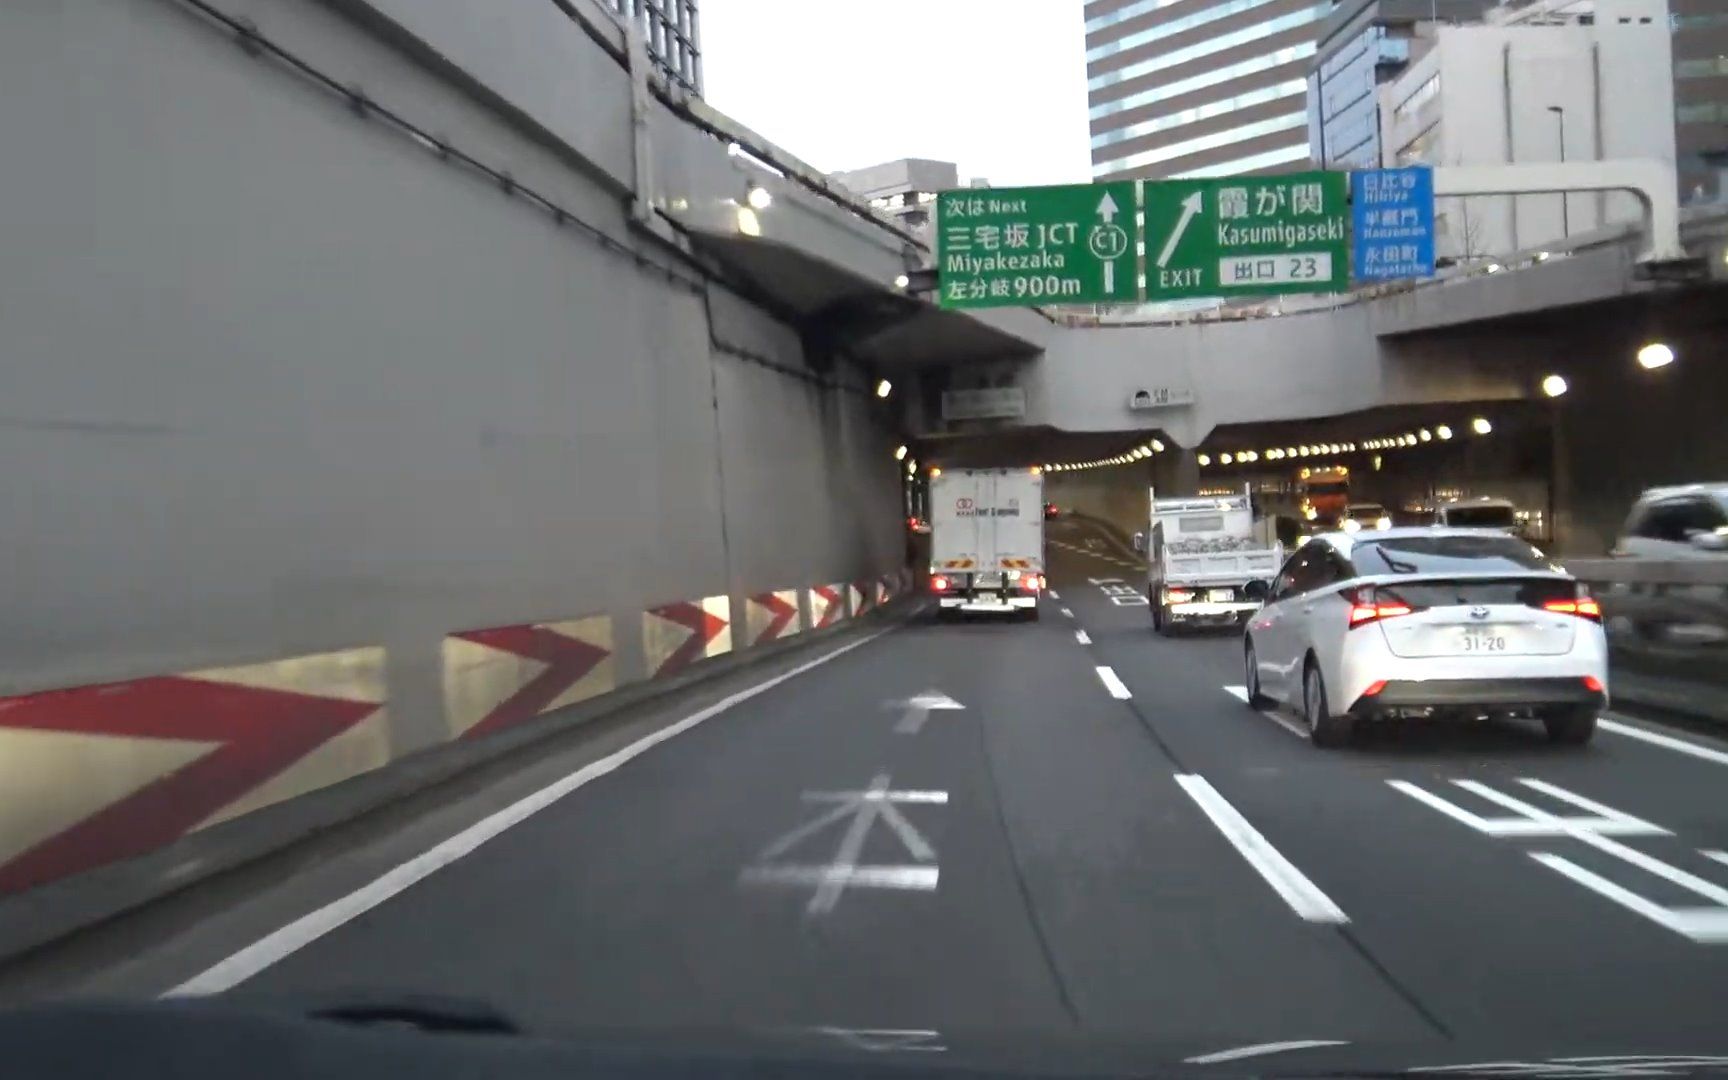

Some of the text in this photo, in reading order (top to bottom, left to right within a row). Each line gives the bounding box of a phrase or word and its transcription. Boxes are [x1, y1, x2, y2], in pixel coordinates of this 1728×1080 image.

[989, 199, 1027, 213] Next
[1218, 182, 1323, 219] 霞が関
[946, 222, 1080, 250] 三宅坂 JCT
[1095, 231, 1118, 251] C1
[1218, 217, 1345, 248] Kasumigaseki
[947, 251, 1065, 275] Miyakezaka
[1234, 258, 1317, 280] 出口 23
[1160, 268, 1202, 288] EXIT
